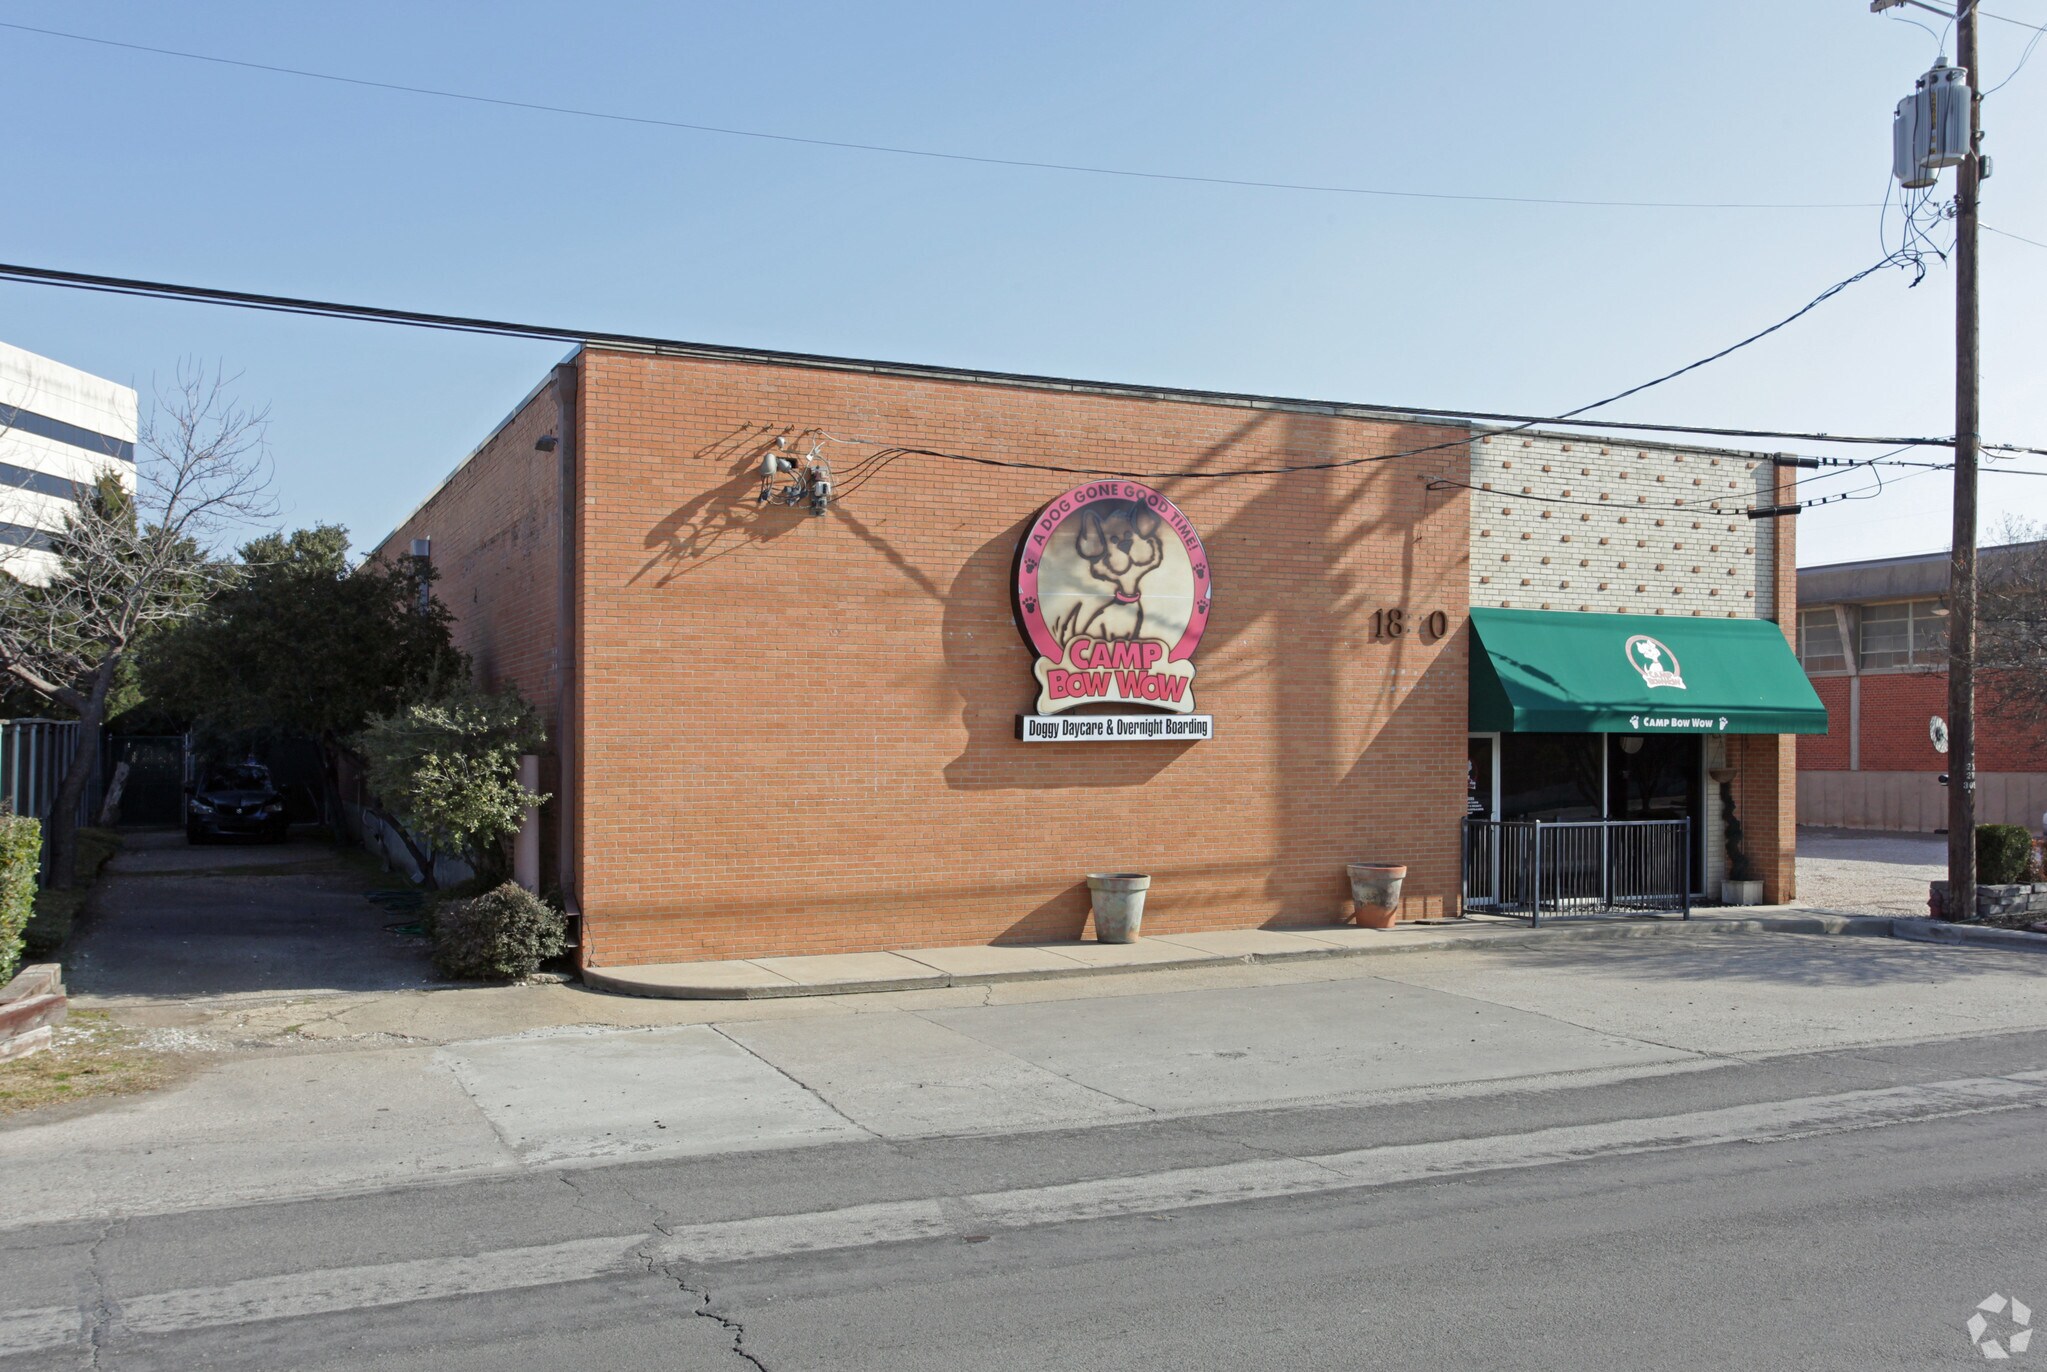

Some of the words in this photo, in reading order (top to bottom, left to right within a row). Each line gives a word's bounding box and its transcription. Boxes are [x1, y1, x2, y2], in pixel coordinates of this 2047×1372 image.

[1033, 534, 1046, 546] A
[1040, 500, 1071, 531] DOG
[1074, 484, 1118, 503] GONE
[1124, 485, 1168, 513] GOOD
[1170, 511, 1199, 551] TIME!
[1069, 639, 1162, 669] CAMP
[1047, 669, 1112, 700] BOW
[1114, 670, 1189, 703] WOW
[1029, 719, 1060, 739] Doggy
[1062, 719, 1104, 738] Daycare
[1106, 719, 1114, 735] &
[1117, 718, 1163, 737] Overnight
[1166, 718, 1208, 736] Boarding
[1643, 717, 1670, 727] CAMP
